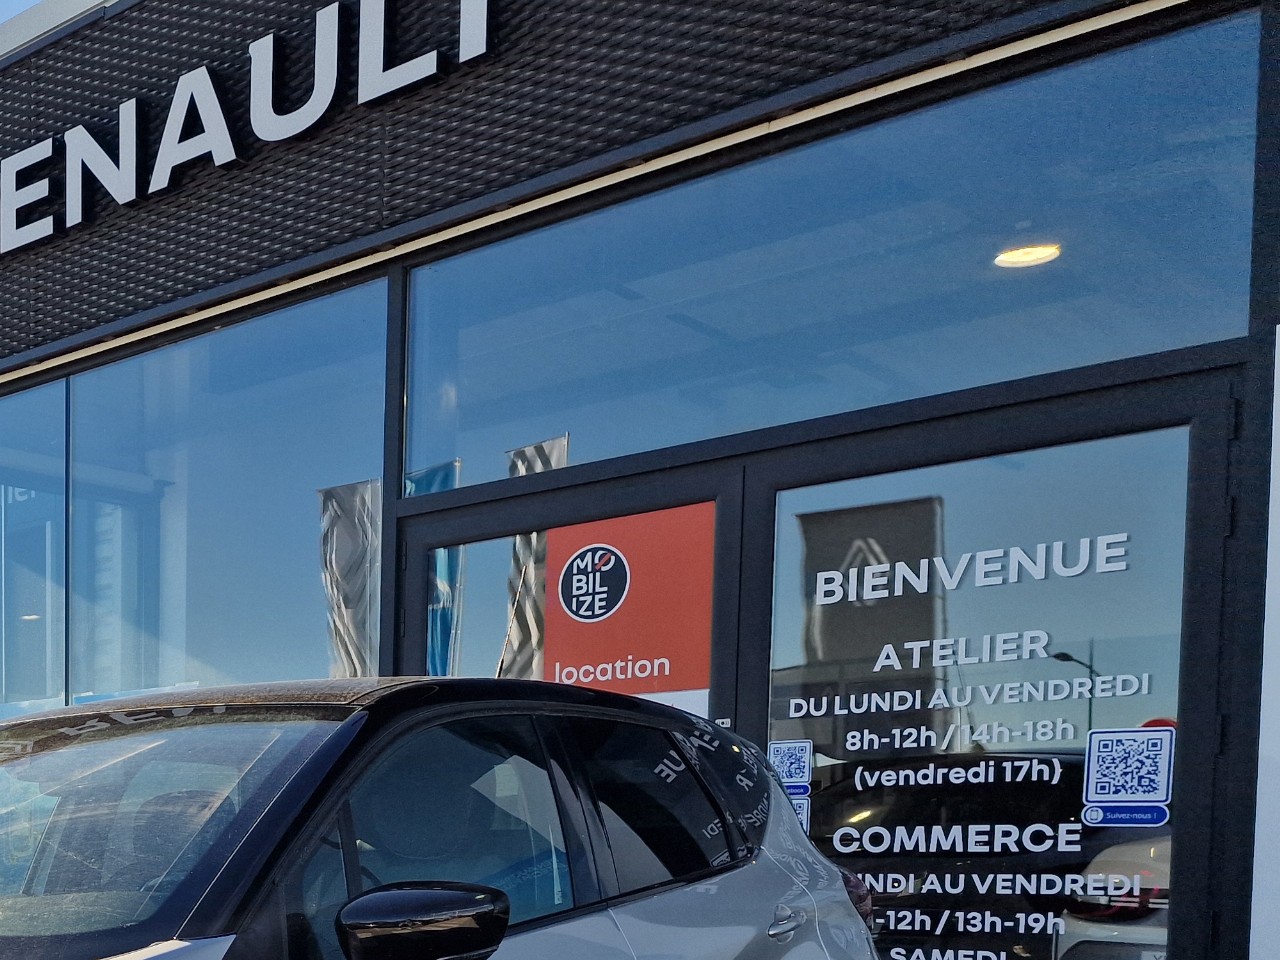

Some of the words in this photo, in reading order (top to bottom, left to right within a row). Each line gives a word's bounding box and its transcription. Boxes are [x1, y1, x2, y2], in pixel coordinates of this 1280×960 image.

[815, 533, 1129, 606] BIENVENUE
[873, 630, 1050, 672] ATELIER
[555, 655, 670, 684] location
[788, 696, 828, 719] DU
[834, 689, 920, 715] LUNDI
[927, 685, 971, 710] AU
[978, 673, 1150, 706] VENDREDI
[854, 762, 996, 791] (vendredi
[1002, 758, 1063, 784] 17h)
[1106, 811, 1152, 820] Suivez-nous
[832, 822, 1083, 854] COMMERCE
[857, 873, 915, 894] NDI
[921, 873, 966, 894] AU
[972, 873, 1141, 897] VENDREDI
